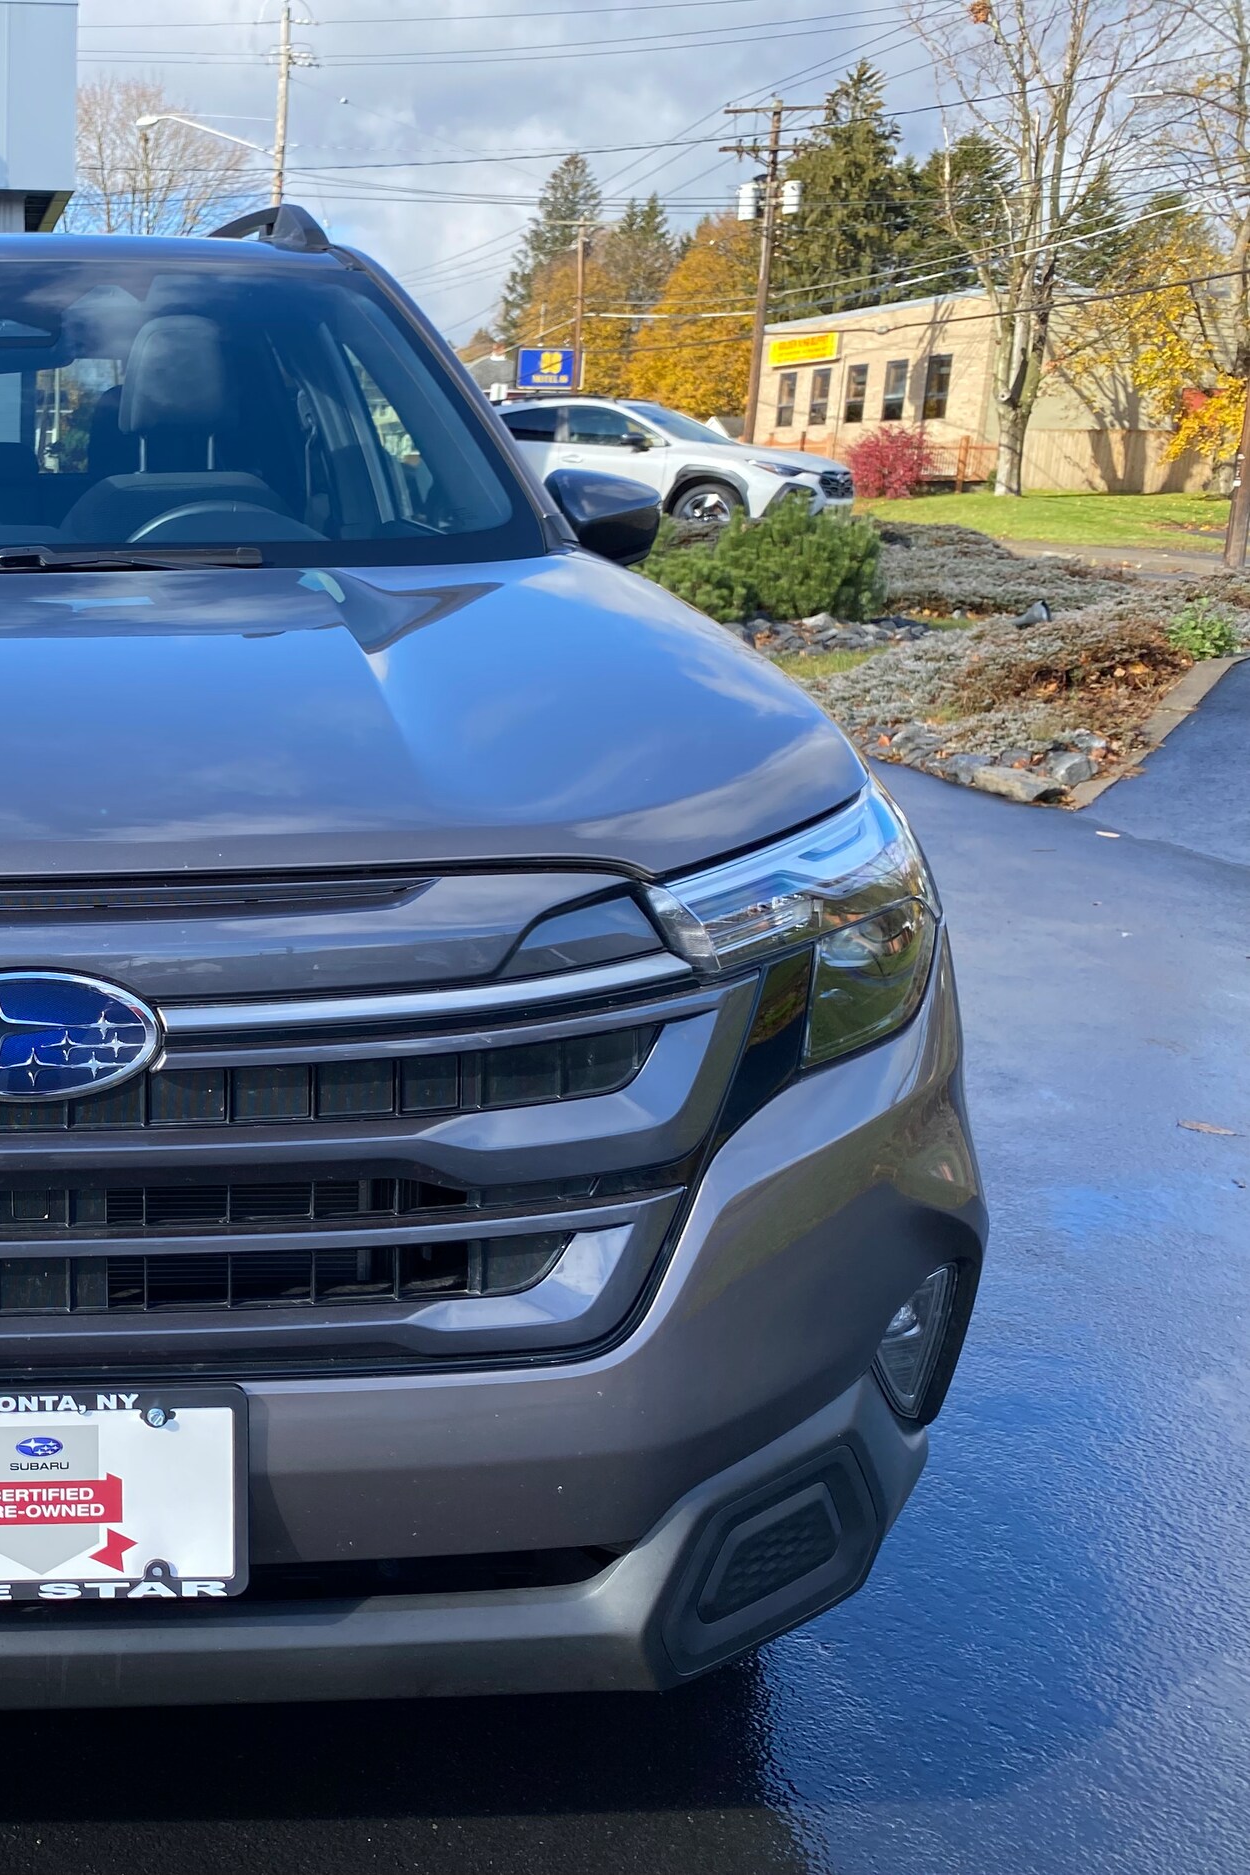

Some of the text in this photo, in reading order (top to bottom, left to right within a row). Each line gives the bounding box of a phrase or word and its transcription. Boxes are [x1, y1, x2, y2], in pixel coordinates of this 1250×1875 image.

[96, 1393, 139, 1410] NY
[9, 1461, 70, 1471] SUBARU
[37, 1581, 229, 1599] STAR
